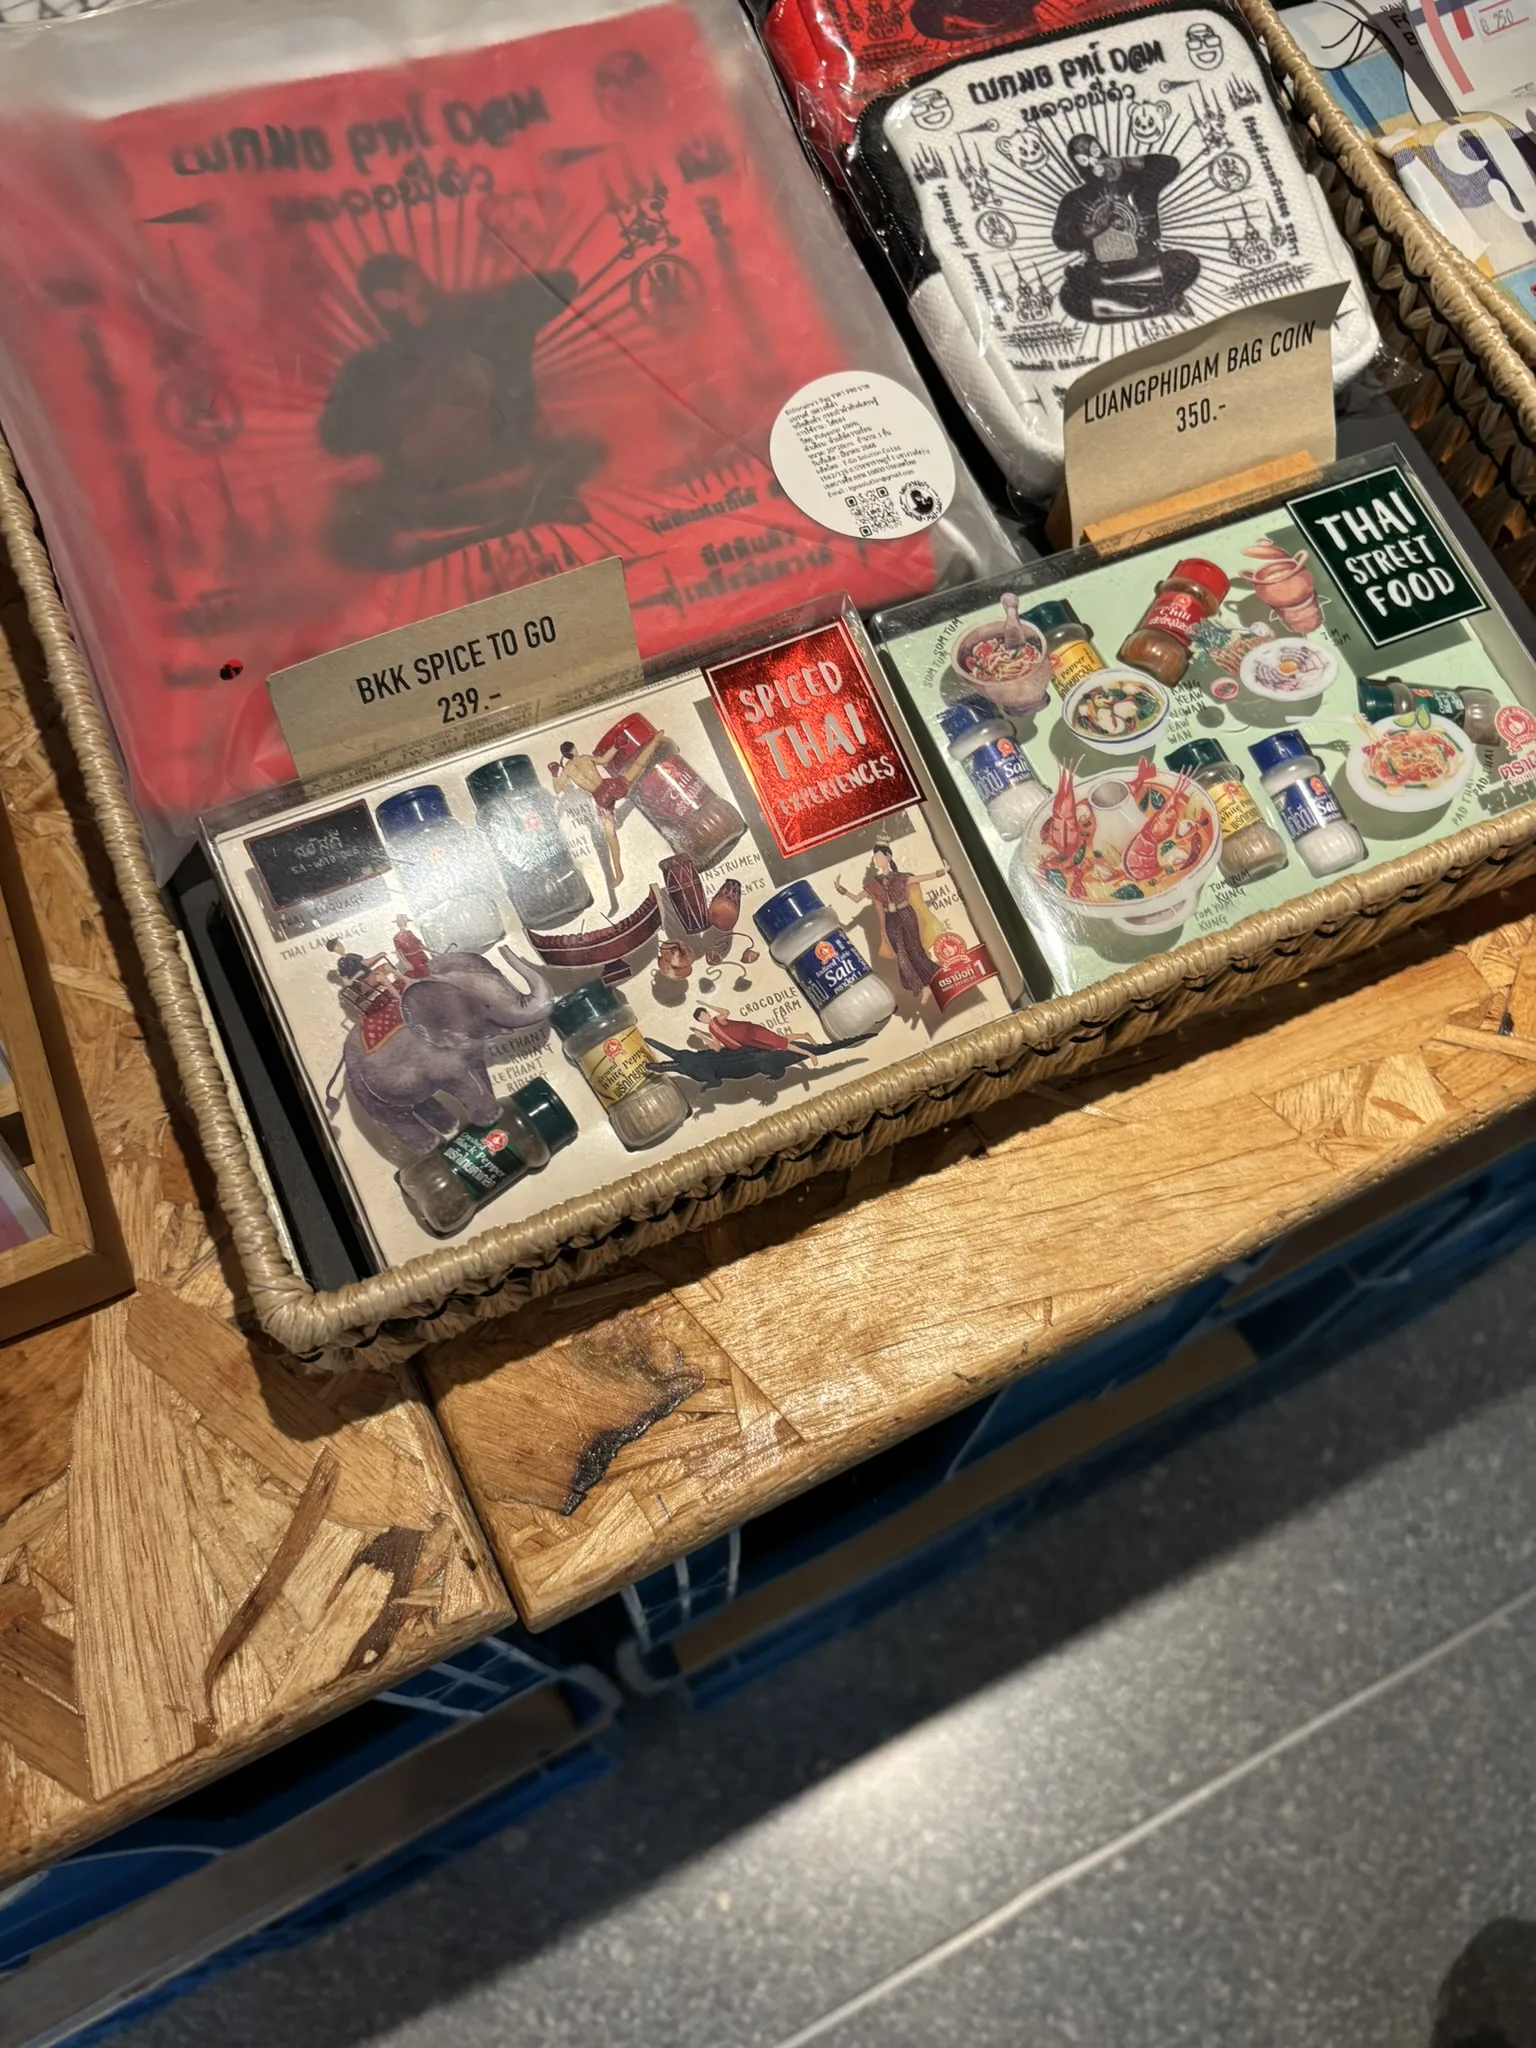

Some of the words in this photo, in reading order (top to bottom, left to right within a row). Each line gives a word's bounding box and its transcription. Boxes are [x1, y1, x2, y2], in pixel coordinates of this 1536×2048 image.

[1493, 9, 1515, 33] 250
[1084, 353, 1220, 423] LUANGPHIDAM
[1227, 338, 1262, 372] BAG
[1270, 320, 1316, 357] COIN
[1176, 397, 1227, 433] 350.-
[1314, 490, 1418, 552] THAI
[1344, 533, 1437, 585] STREET
[1364, 566, 1456, 618] FOOD
[356, 664, 411, 704] BKK
[414, 638, 486, 686] SPICE
[487, 628, 518, 661] TO
[524, 615, 557, 649] GO
[437, 687, 502, 724] 239.-
[739, 660, 843, 724] SPICED
[756, 703, 868, 781] THAI
[778, 754, 896, 816] EXPERIENCES
[824, 958, 857, 988] Salt
[973, 958, 987, 977] 1
[739, 986, 798, 1017] CROCODILE
[773, 999, 802, 1018] FARM
[600, 1068, 624, 1090] White
[475, 1151, 507, 1178] Pepper
